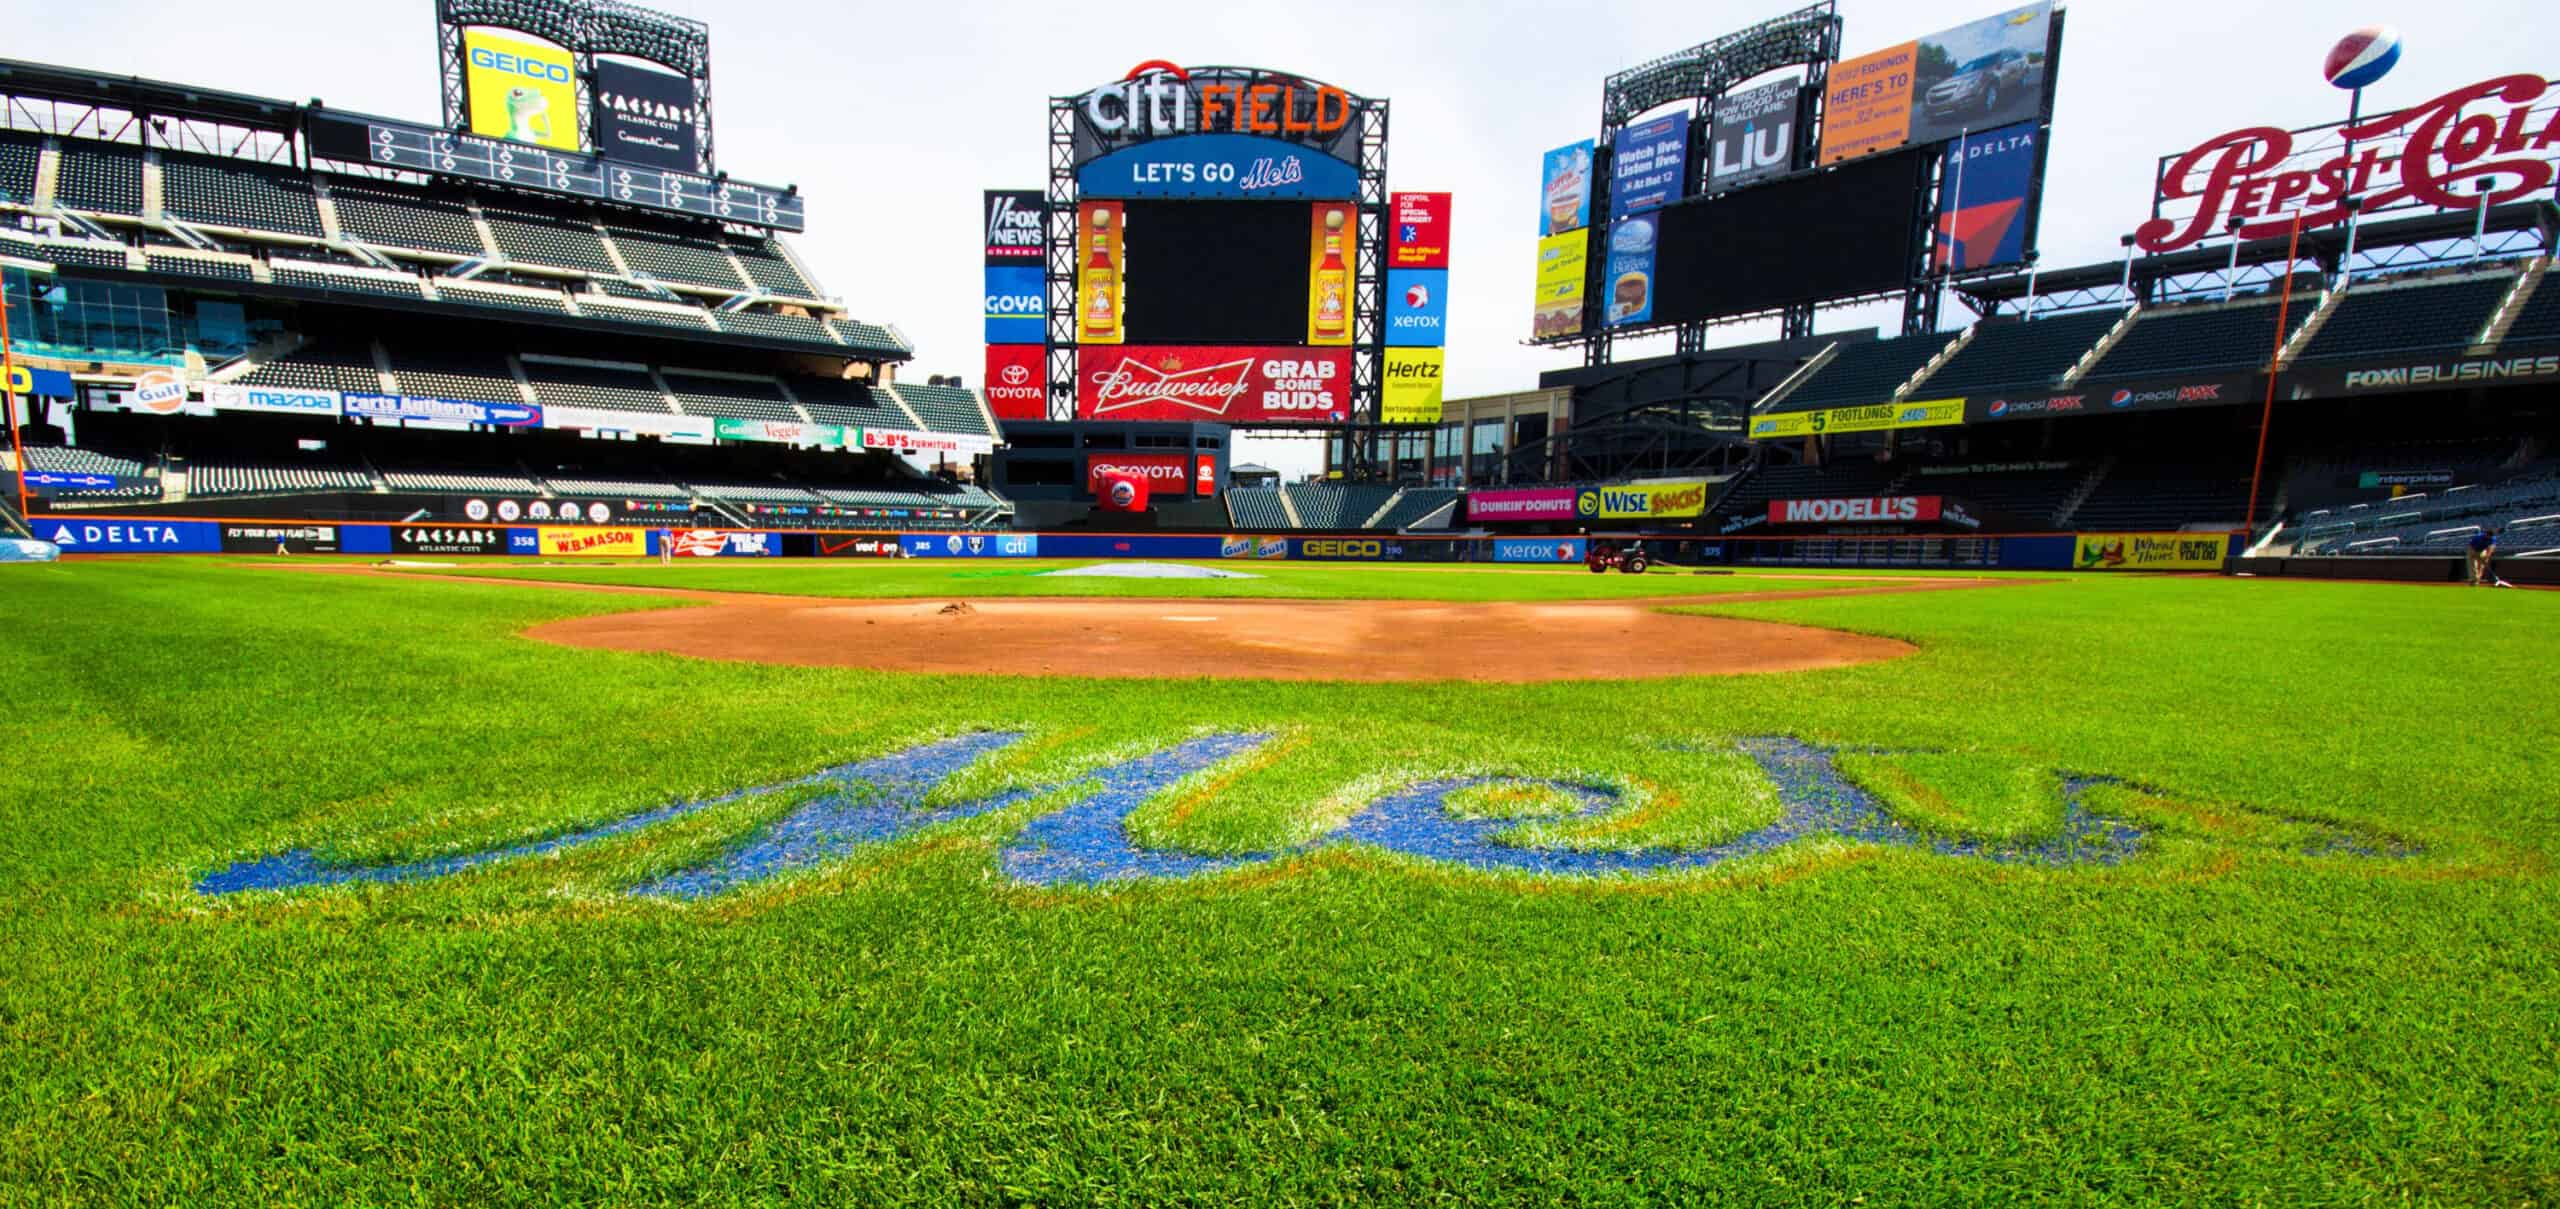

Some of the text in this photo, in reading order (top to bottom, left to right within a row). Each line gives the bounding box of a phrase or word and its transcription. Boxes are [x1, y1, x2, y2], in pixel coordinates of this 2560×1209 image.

[471, 47, 570, 83] GEICO
[1760, 84, 1780, 95] OUT
[1831, 79, 1883, 105] HERE'S
[1888, 72, 1908, 89] TO
[600, 91, 693, 124] CAESARS
[1202, 84, 1349, 131] FIELD
[1714, 105, 1739, 118] HOW
[1776, 87, 1798, 100] YOU
[617, 113, 678, 131] ATLANTIC CITY
[434, 131, 497, 147] AMRICAN
[1970, 134, 2032, 159] DELTA
[1618, 145, 1655, 163] Watch
[1713, 121, 1790, 177] LIU
[1133, 155, 1303, 190] LET'S GO Mets
[1618, 161, 1653, 178] Listen
[1005, 210, 1042, 228] FOX
[994, 228, 1043, 245] NEWS
[986, 295, 1043, 313] GOYA
[1393, 314, 1439, 328] xerox
[1262, 360, 1336, 379] GRAB
[1387, 361, 1440, 378] Hertz
[2345, 367, 2400, 389] FOX
[138, 383, 181, 401] Gulf
[988, 387, 1043, 399] TOYOTA
[1092, 371, 1249, 400] Budweiser
[1274, 379, 1323, 391] SOME
[2134, 384, 2223, 402] pepsi MAX
[249, 391, 332, 409] mazda
[1262, 392, 1334, 410] BUDS
[2009, 395, 2086, 412] pepsi MAX
[1808, 411, 1826, 431] $5
[1831, 406, 1895, 422] FOOTLONGS
[911, 439, 958, 450] FURNITURE
[2368, 473, 2450, 484] nterprise
[1527, 498, 1572, 511] DONUTS
[1603, 491, 1648, 513] WISE
[1786, 496, 1919, 522] MODELL'S
[84, 526, 179, 543] DELTA
[227, 528, 242, 538] FLY
[243, 528, 265, 538] YOUR
[400, 529, 497, 544] CAESARS
[513, 536, 536, 546] 358
[855, 541, 898, 552] verizon
[1005, 538, 1026, 553] citi
[1223, 541, 1249, 556] Gulf
[1258, 540, 1286, 556] Gulf
[1302, 540, 1381, 556] GEICO
[1503, 544, 1553, 558] xerox
[2180, 550, 2200, 561] YOU
[2202, 550, 2217, 561] DO
